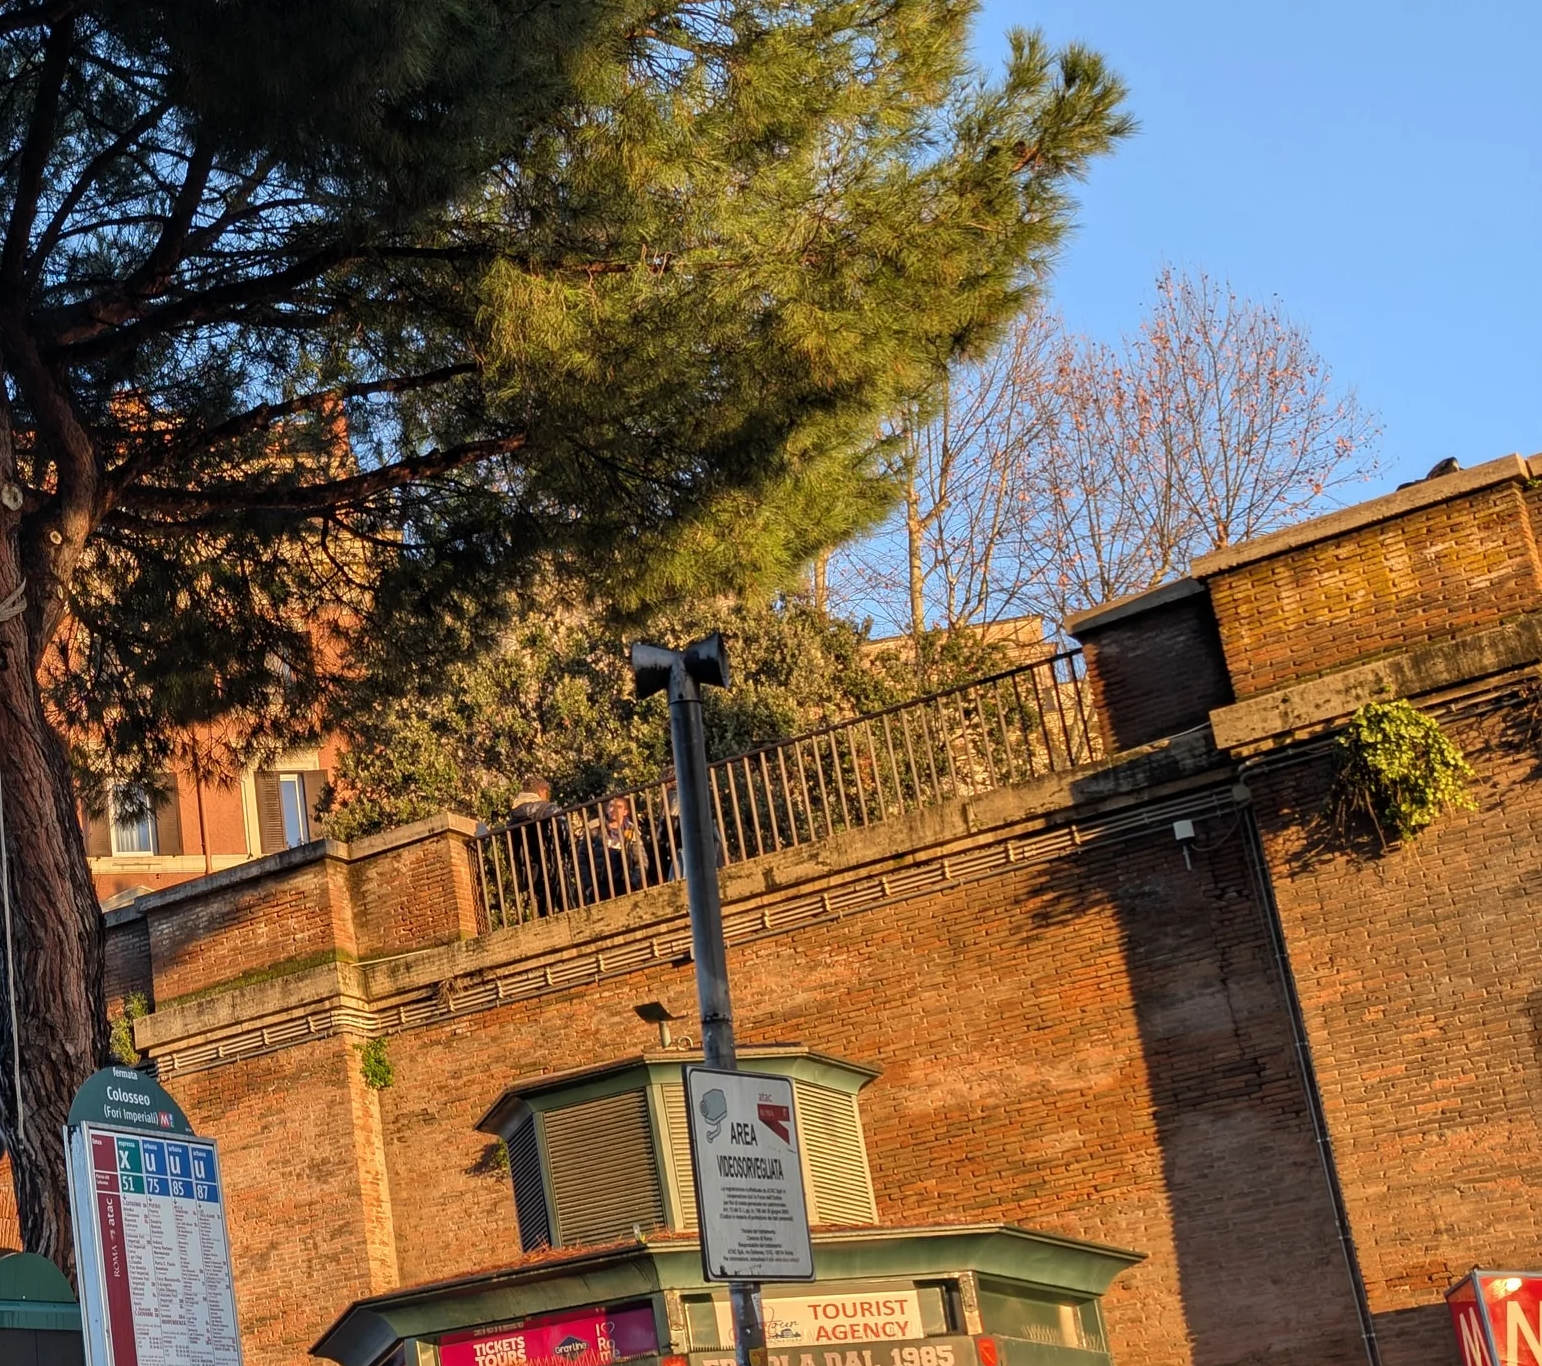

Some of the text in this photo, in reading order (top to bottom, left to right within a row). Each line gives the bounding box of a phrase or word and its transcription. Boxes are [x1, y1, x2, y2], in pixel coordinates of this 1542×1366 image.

[112, 1066, 138, 1081] fermata
[106, 1086, 151, 1106] Colosseo
[103, 1104, 159, 1126] (Fori Imperiali)
[730, 1121, 758, 1147] AREA
[716, 1154, 785, 1181] VIDEOSORVEGLIATA
[122, 1176, 135, 1192] 51
[147, 1178, 160, 1194] 75
[172, 1180, 185, 1196] 85
[197, 1184, 208, 1200] 87
[106, 1197, 116, 1227] atac
[111, 1244, 121, 1277] ROMA
[808, 1299, 908, 1321] TOURIST
[815, 1320, 909, 1342] AGENCY
[473, 1336, 525, 1356] TICKETS
